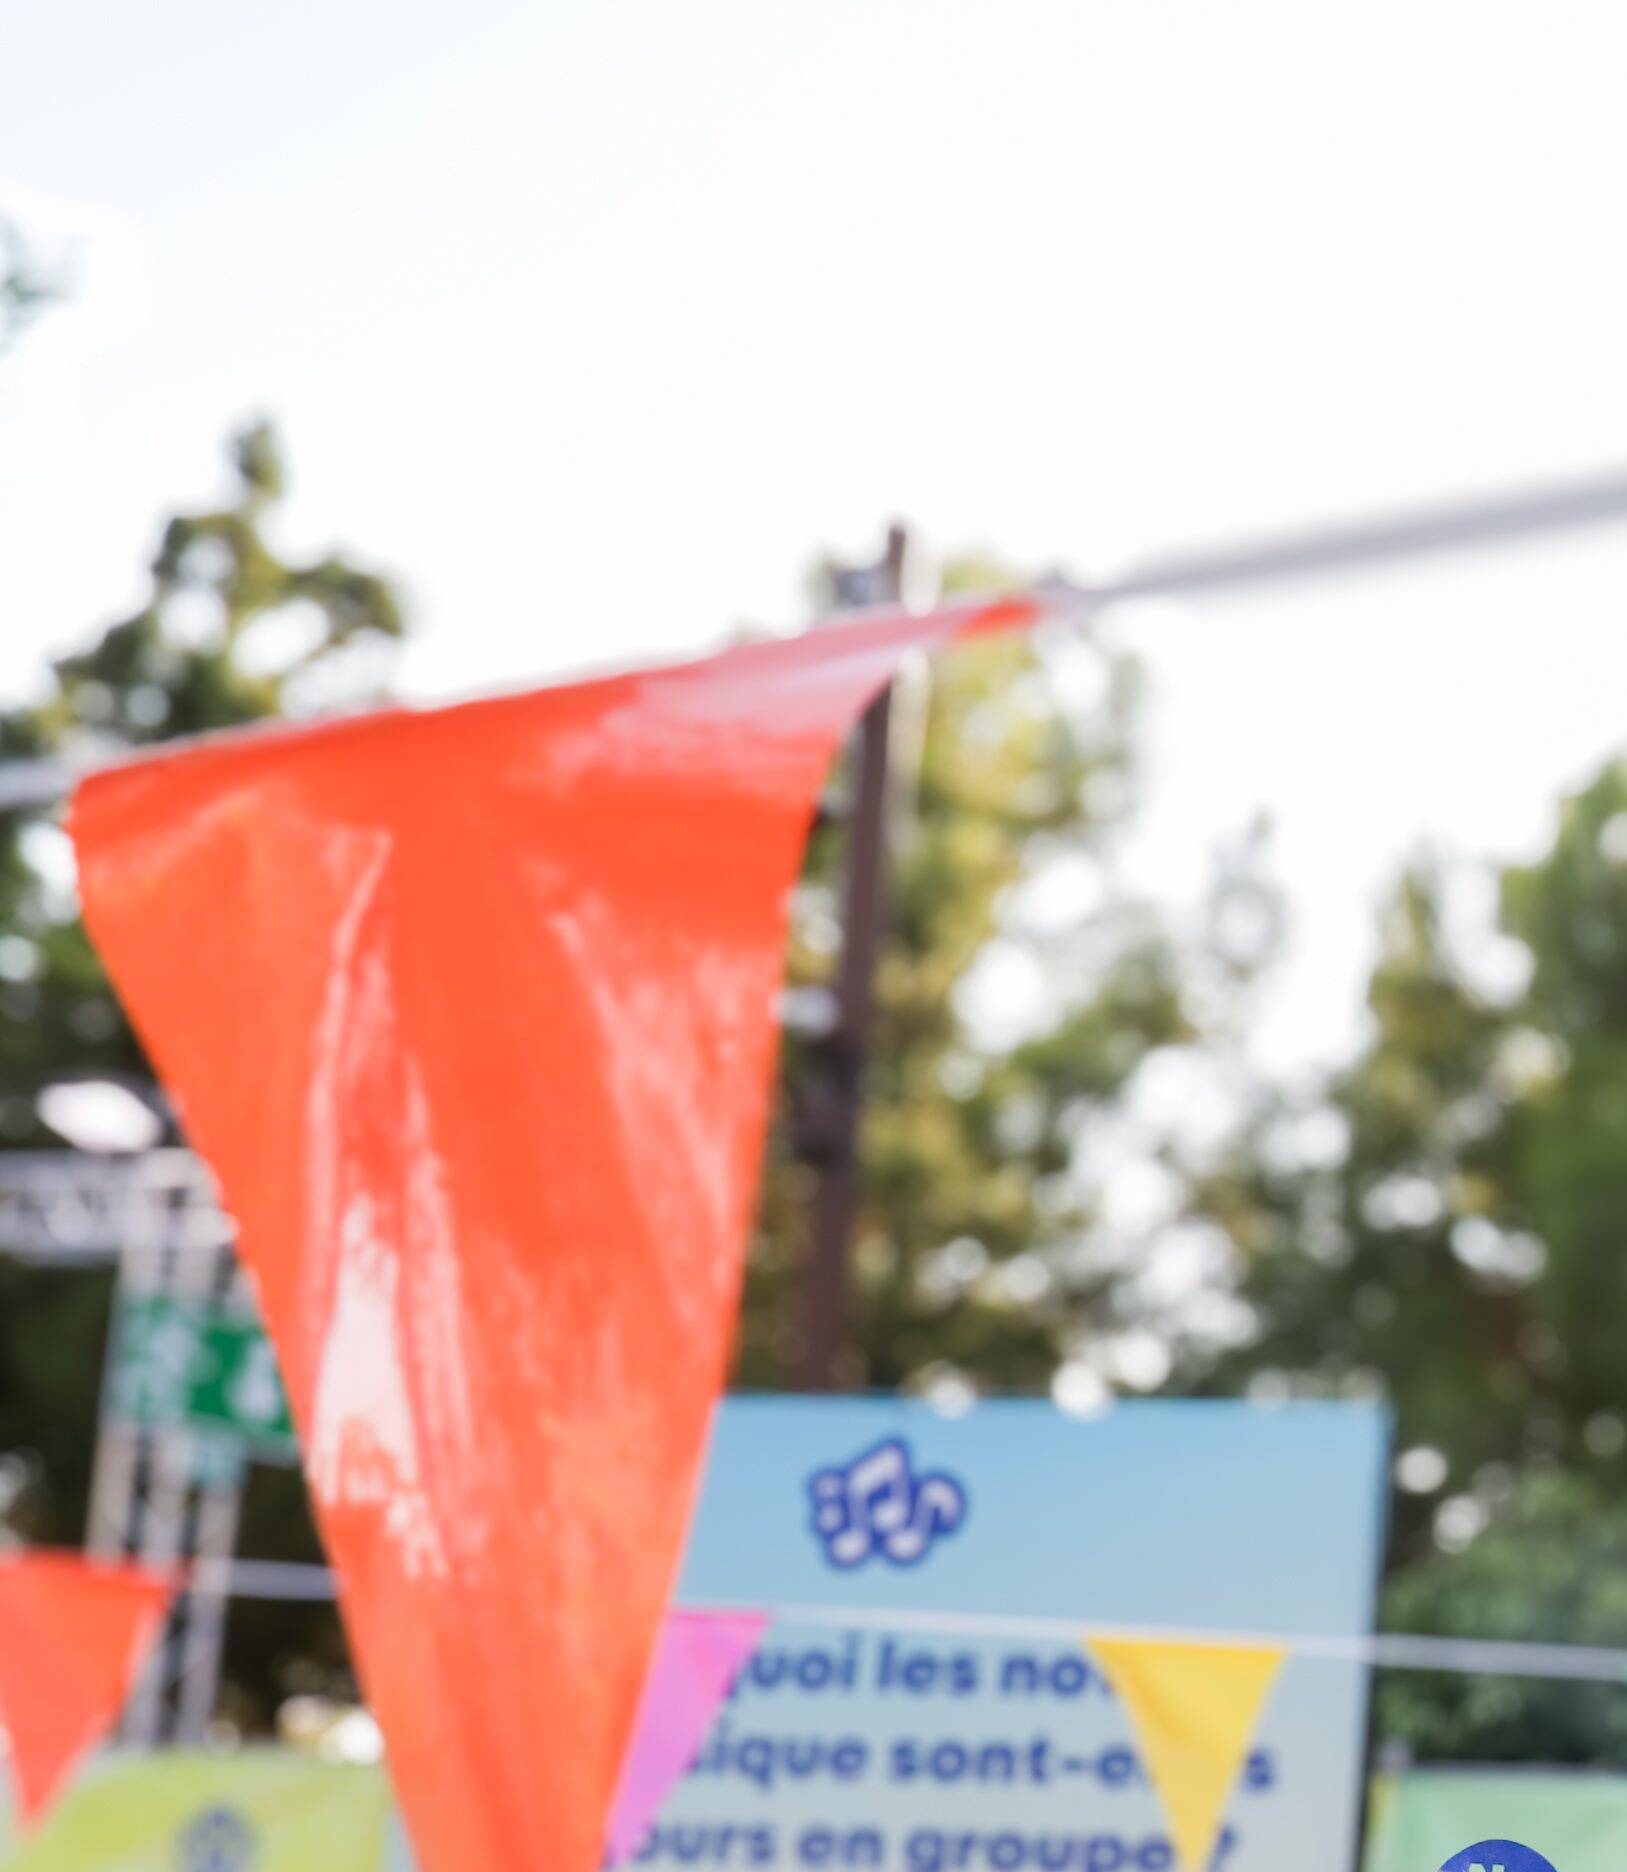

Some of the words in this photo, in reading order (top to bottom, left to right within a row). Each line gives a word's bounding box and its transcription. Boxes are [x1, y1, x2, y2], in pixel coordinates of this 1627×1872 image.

[878, 1639, 979, 1695] les
[690, 1718, 869, 1788] ique
[604, 1822, 776, 1872] ours
[793, 1828, 886, 1870] en
